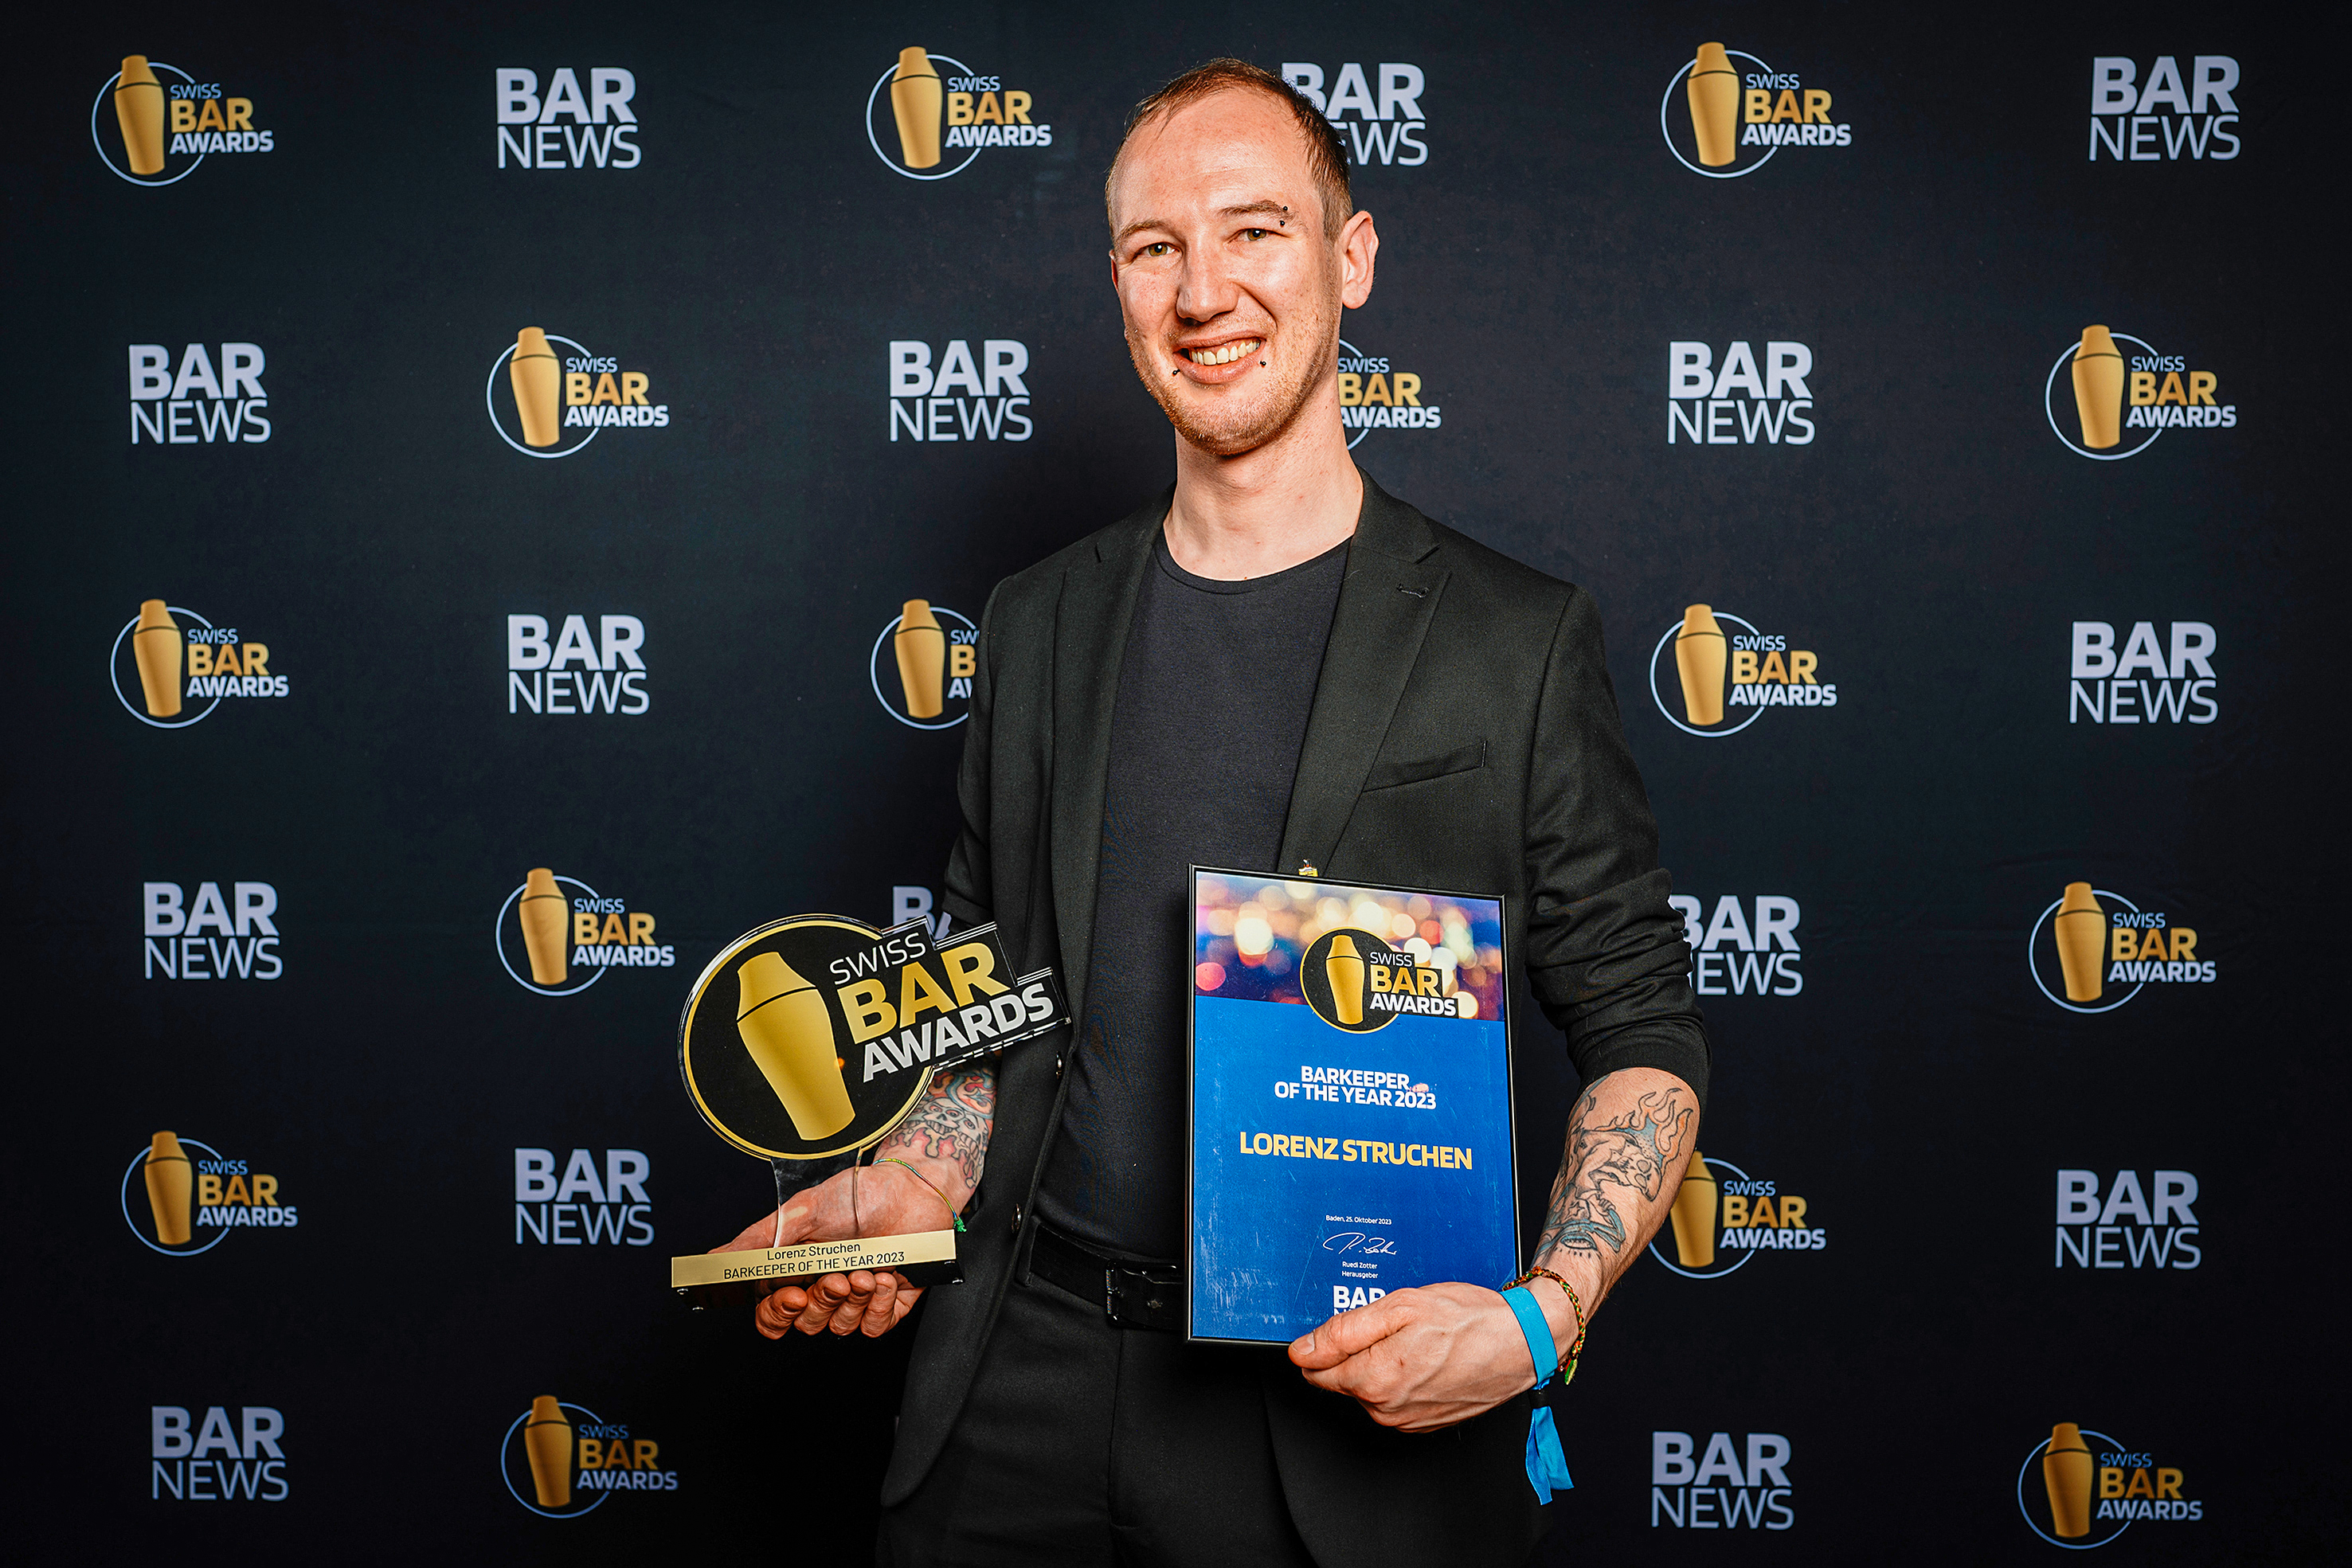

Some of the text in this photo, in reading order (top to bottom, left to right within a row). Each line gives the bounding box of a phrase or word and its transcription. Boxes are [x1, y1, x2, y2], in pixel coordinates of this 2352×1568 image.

[170, 84, 222, 100] SWISS
[496, 68, 638, 124] BAR
[948, 76, 1000, 92] SWISS
[1282, 62, 1426, 120] BAR
[1745, 73, 1799, 90] SWISS
[2091, 56, 2240, 115] BAR
[170, 98, 253, 132] BAR
[948, 91, 1032, 126] BAR
[1745, 88, 1832, 124] BAR
[170, 131, 274, 154] AWARDS
[498, 125, 641, 169] NEWS
[945, 124, 1052, 147] AWARDS
[1741, 123, 1853, 147] AWARDS
[2089, 115, 2240, 161] NEWS
[129, 343, 268, 401] BAR
[565, 357, 618, 373] SWISS
[890, 340, 1031, 397] BAR
[1338, 358, 1390, 373] SWISS
[1669, 341, 1814, 400] BAR
[2131, 356, 2186, 373] SWISS
[565, 372, 649, 406] BAR
[1338, 372, 1422, 407] BAR
[2130, 371, 2217, 406] BAR
[131, 400, 272, 444] NEWS
[564, 405, 670, 428] AWARDS
[890, 397, 1033, 442] NEWS
[1340, 405, 1442, 428] AWARDS
[1668, 400, 1815, 444] NEWS
[2126, 405, 2237, 428] AWARDS
[188, 628, 238, 644] SWISS
[507, 614, 647, 671] BAR
[1732, 635, 1787, 651] SWISS
[2071, 621, 2217, 679] BAR
[188, 643, 269, 677] BAR
[1732, 650, 1818, 685] BAR
[186, 675, 289, 698] AWARDS
[509, 671, 650, 714] NEWS
[1728, 684, 1838, 706] AWARDS
[2069, 679, 2218, 724] NEWS
[143, 882, 280, 937] BAR
[573, 897, 626, 913] SWISS
[2112, 912, 2166, 929] SWISS
[573, 913, 656, 946] BAR
[1668, 894, 1801, 952] BAR
[145, 937, 284, 980] NEWS
[572, 944, 676, 967] AWARDS
[829, 933, 926, 986] SWISS
[1370, 952, 1413, 967] SWISS
[2111, 927, 2197, 961] BAR
[1371, 964, 1442, 997] BAR
[1688, 952, 1803, 996] EWS
[2108, 960, 2217, 983] AWARDS
[836, 942, 1012, 1044] BAR
[1369, 992, 1457, 1017] AWARDS
[863, 983, 1055, 1083] AWARDS
[1301, 1066, 1410, 1090] BARKEEPER
[1274, 1081, 1437, 1109] OF THE YEAR 2023
[198, 1159, 249, 1175] SWISS
[1240, 1131, 1473, 1170] LORENZ STRUCHEN
[198, 1174, 278, 1206] BAR
[515, 1148, 652, 1202] BAR
[1724, 1180, 1776, 1196] SWISS
[1723, 1195, 1807, 1228] BAR
[2057, 1169, 2199, 1226] BAR
[196, 1206, 299, 1227] AWARDS
[516, 1203, 655, 1245] NEWS
[767, 1243, 861, 1261] Lorenz Struchen
[1719, 1227, 1827, 1250] AWARDS
[2056, 1226, 2201, 1269] NEWS
[724, 1251, 905, 1280] BARKEEPER OF THE YEAR 2023
[1341, 1270, 1379, 1279] Herausgeber
[152, 1406, 285, 1459] BAR
[579, 1424, 629, 1437] SWISS
[579, 1438, 658, 1469] BAR
[1652, 1432, 1792, 1487] BAR
[2100, 1453, 2153, 1468] SWISS
[153, 1460, 288, 1500] NEWS
[577, 1470, 678, 1490] AWARDS
[2100, 1467, 2183, 1500] BAR
[1652, 1487, 1794, 1530] NEWS
[2096, 1500, 2203, 1520] AWARDS
